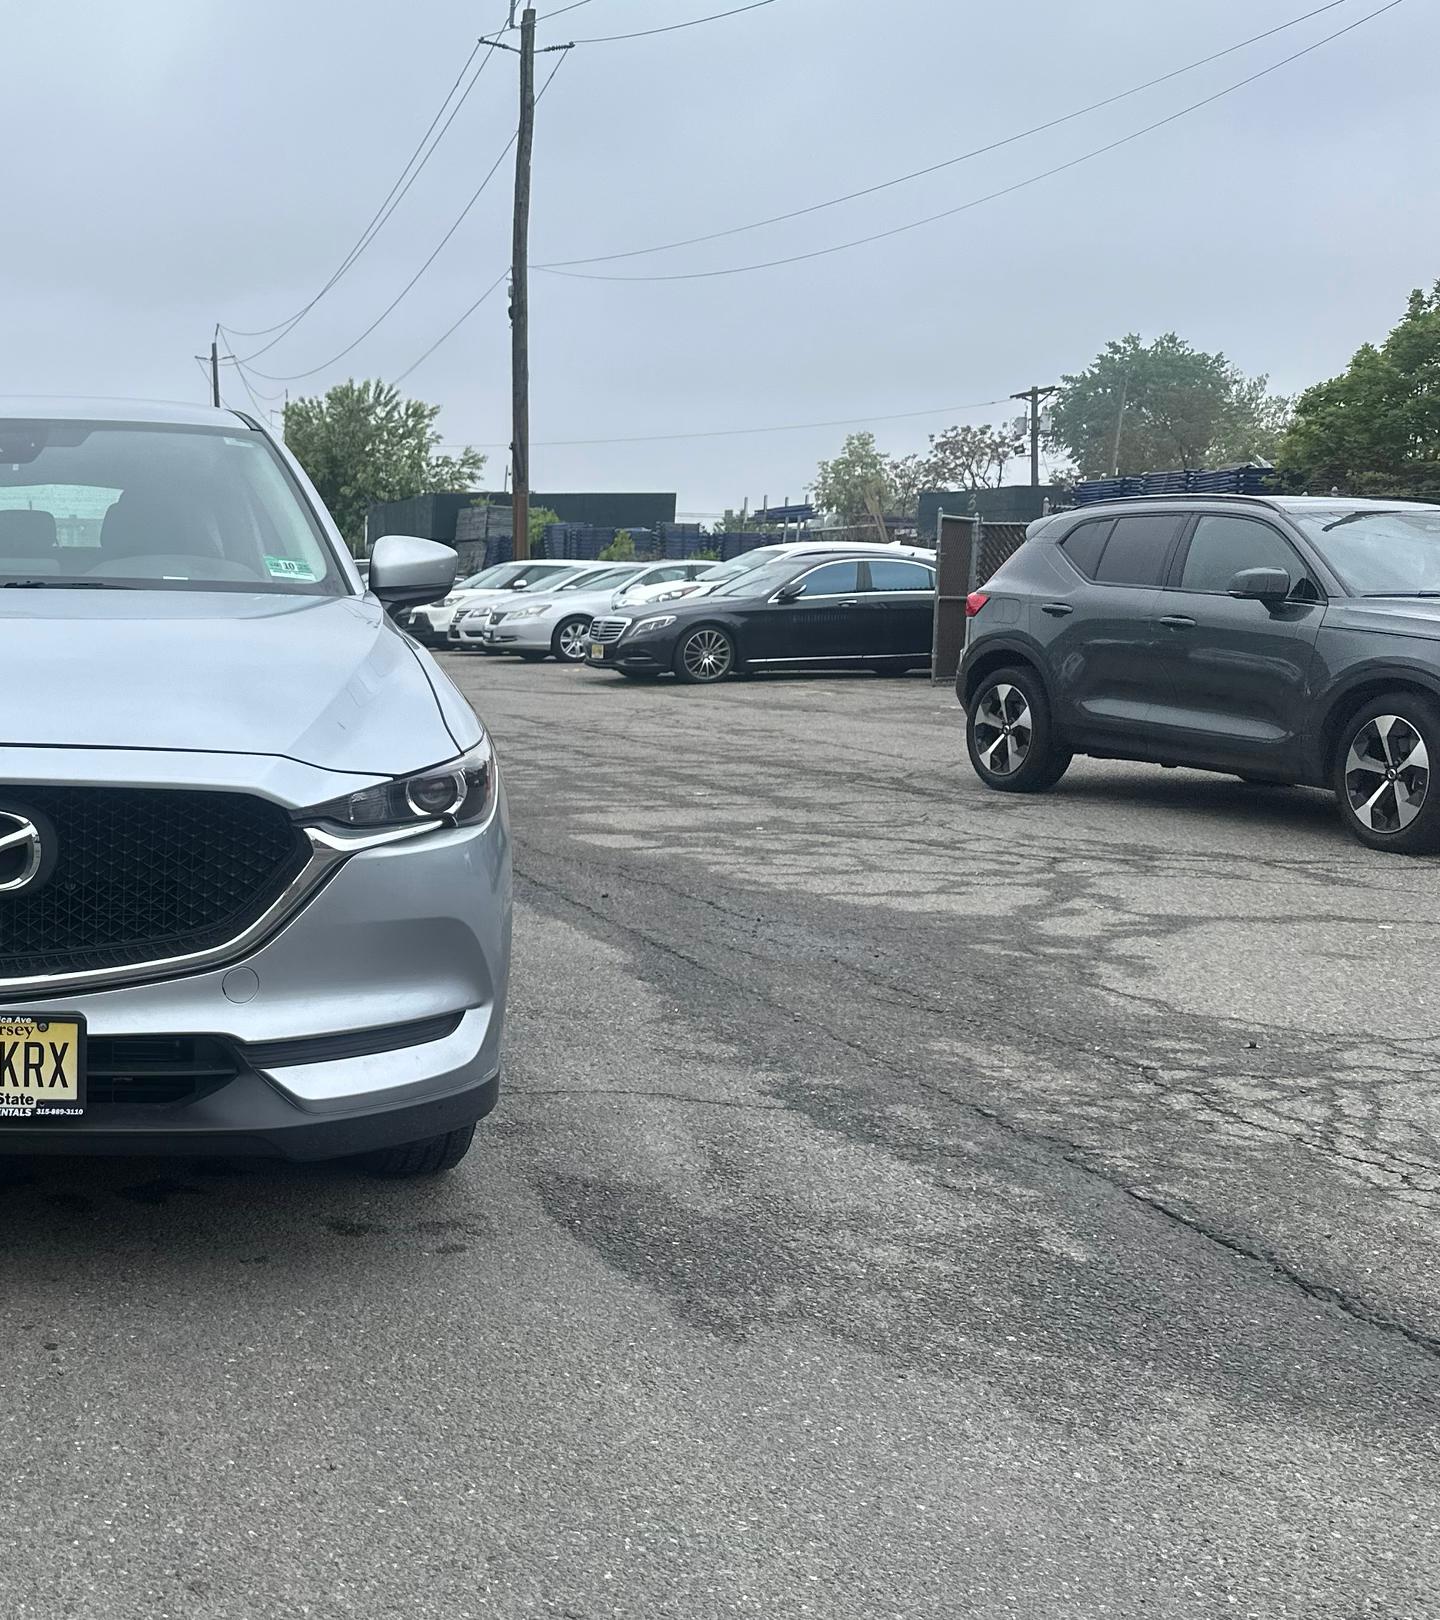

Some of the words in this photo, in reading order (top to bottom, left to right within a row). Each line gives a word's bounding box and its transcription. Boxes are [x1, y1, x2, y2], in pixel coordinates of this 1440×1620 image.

[283, 561, 295, 570] 10
[14, 1016, 32, 1024] Ave
[0, 1041, 69, 1088] KRX
